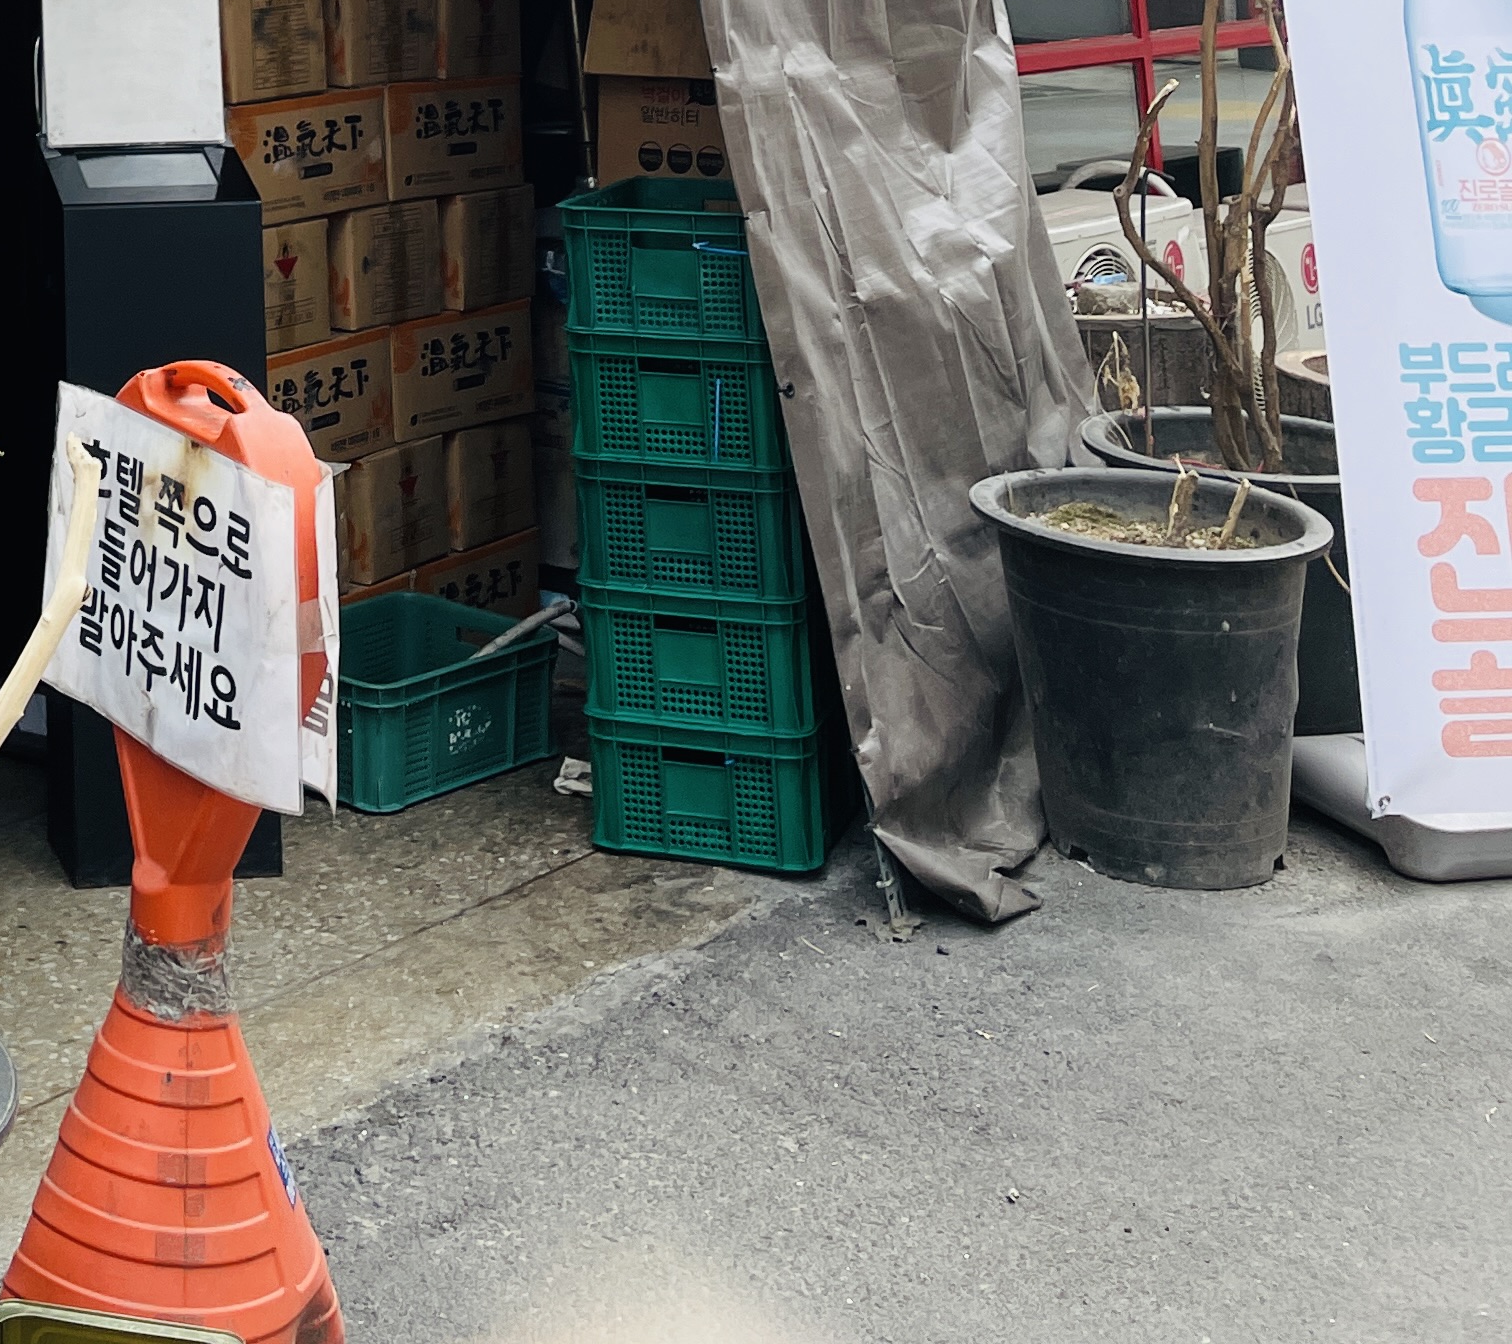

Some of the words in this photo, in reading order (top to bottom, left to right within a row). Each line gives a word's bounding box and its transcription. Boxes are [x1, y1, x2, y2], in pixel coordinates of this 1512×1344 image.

[98, 517, 225, 653] 들어가지
[153, 473, 253, 580] 쪽으로
[79, 587, 241, 731] 말아주세요
